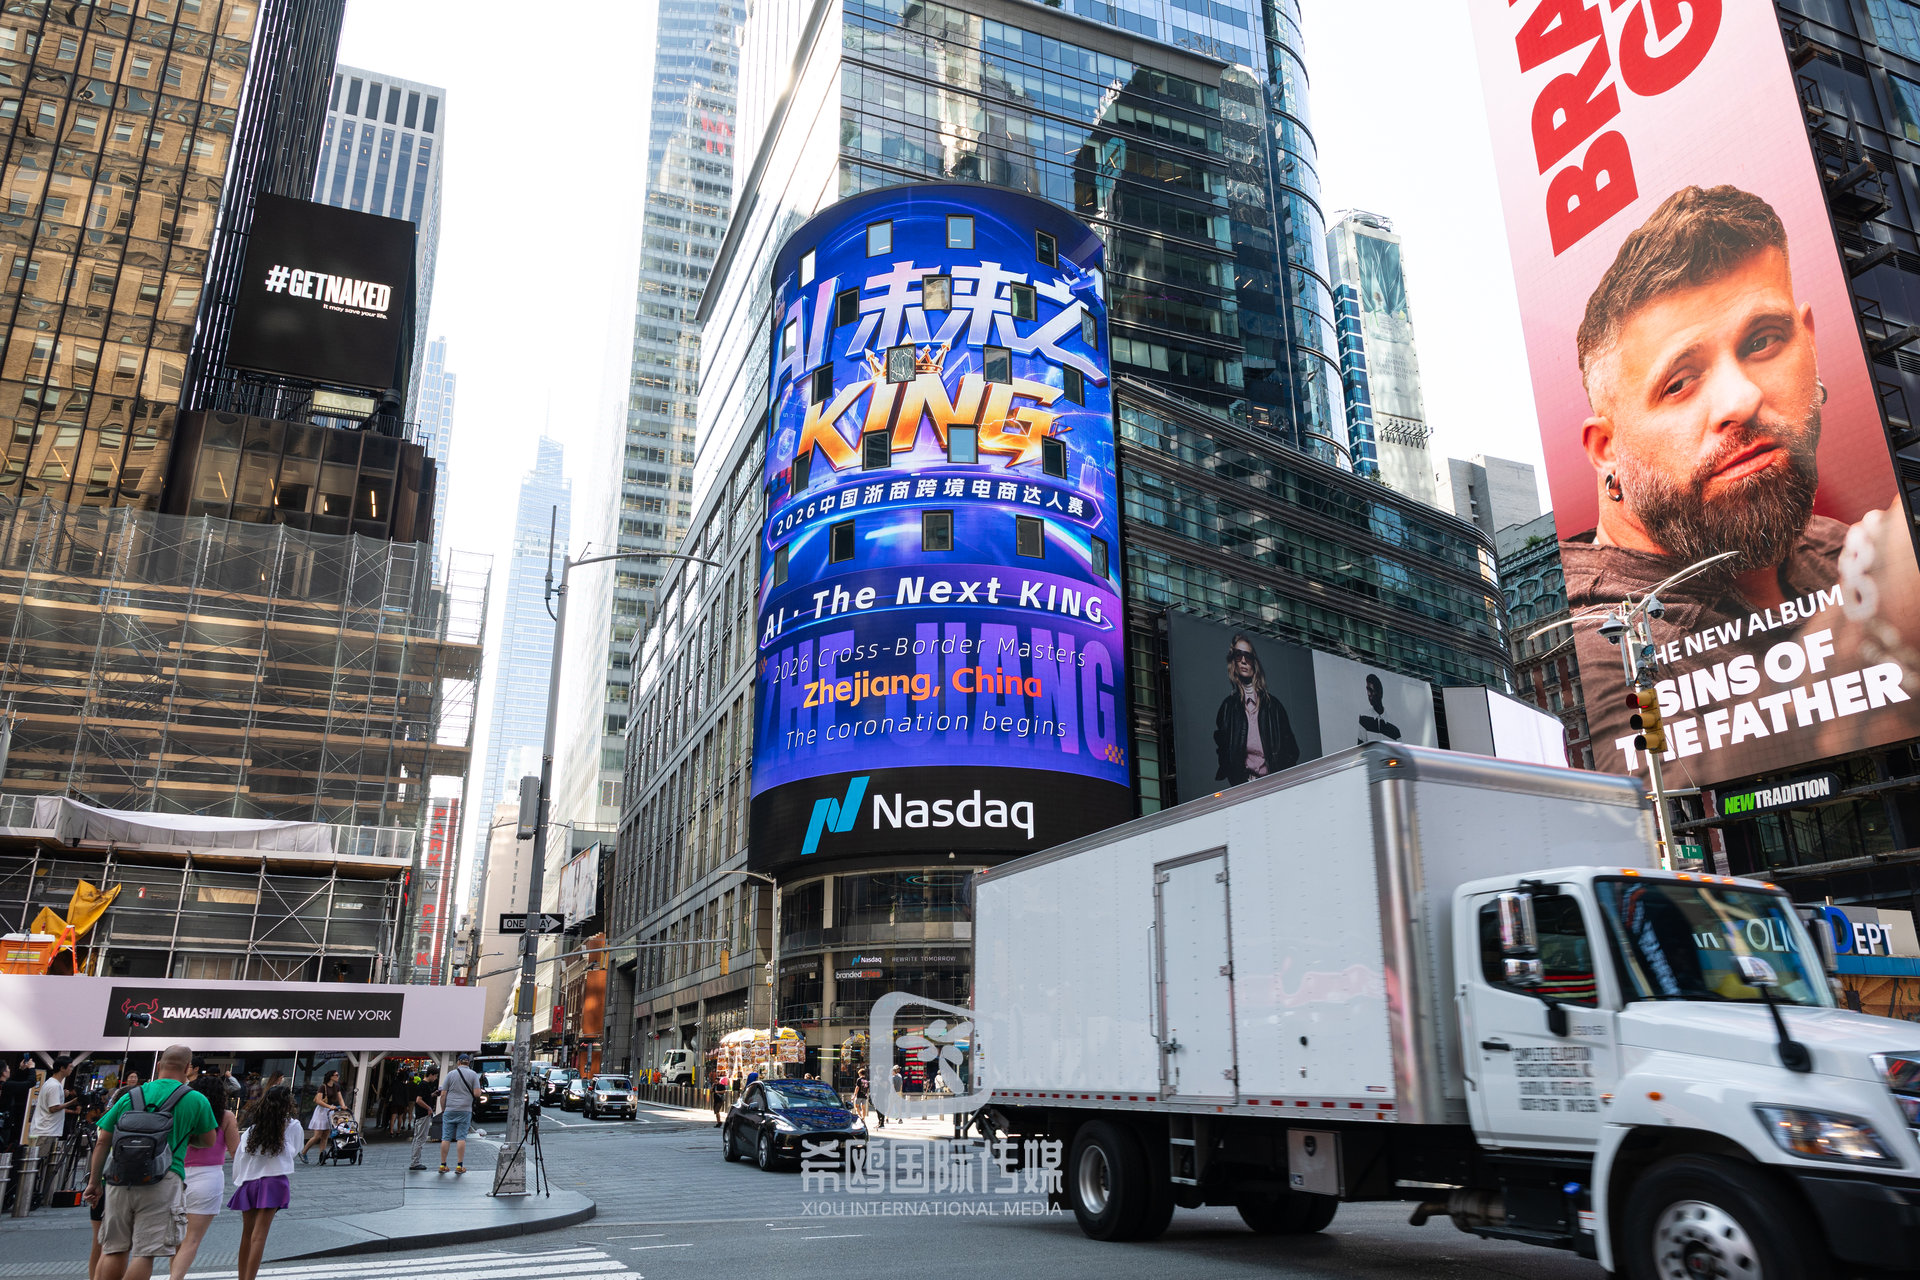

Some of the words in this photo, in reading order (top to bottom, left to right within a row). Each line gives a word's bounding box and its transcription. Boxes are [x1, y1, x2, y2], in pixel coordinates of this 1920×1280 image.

[1508, 0, 1639, 258] BRA
[264, 264, 391, 312] #GETNAKED
[329, 305, 344, 313] may
[345, 307, 361, 315] save
[361, 310, 377, 318] your
[798, 373, 1066, 472] KING
[764, 607, 785, 643] AI
[813, 584, 876, 619] The
[895, 576, 1001, 605] Next
[1019, 580, 1102, 623] KING
[1654, 640, 1683, 666] HE
[1684, 619, 1742, 657] NEW
[1748, 584, 1845, 636] ALBUM
[773, 653, 810, 684] 2026
[818, 633, 987, 668] Cross-Border
[997, 637, 1087, 667] Masters
[1653, 654, 1760, 718] SINS
[1764, 628, 1835, 683] OF
[803, 670, 941, 709] Zhejiang,
[952, 666, 1042, 698] China
[1703, 662, 1911, 750] FATHER
[786, 728, 817, 750] The
[826, 711, 969, 741] coronation
[983, 711, 1067, 738] begins
[427, 807, 447, 867] PARK
[873, 789, 1035, 840] Nasdaq
[416, 904, 436, 967] PARK
[506, 919, 524, 928] ONE
[1821, 906, 1894, 955] DEPT
[861, 956, 882, 964] Nasdaq
[162, 1007, 222, 1019] TAMASHII
[326, 1009, 358, 1020] NEW
[358, 1010, 392, 1021] YORK
